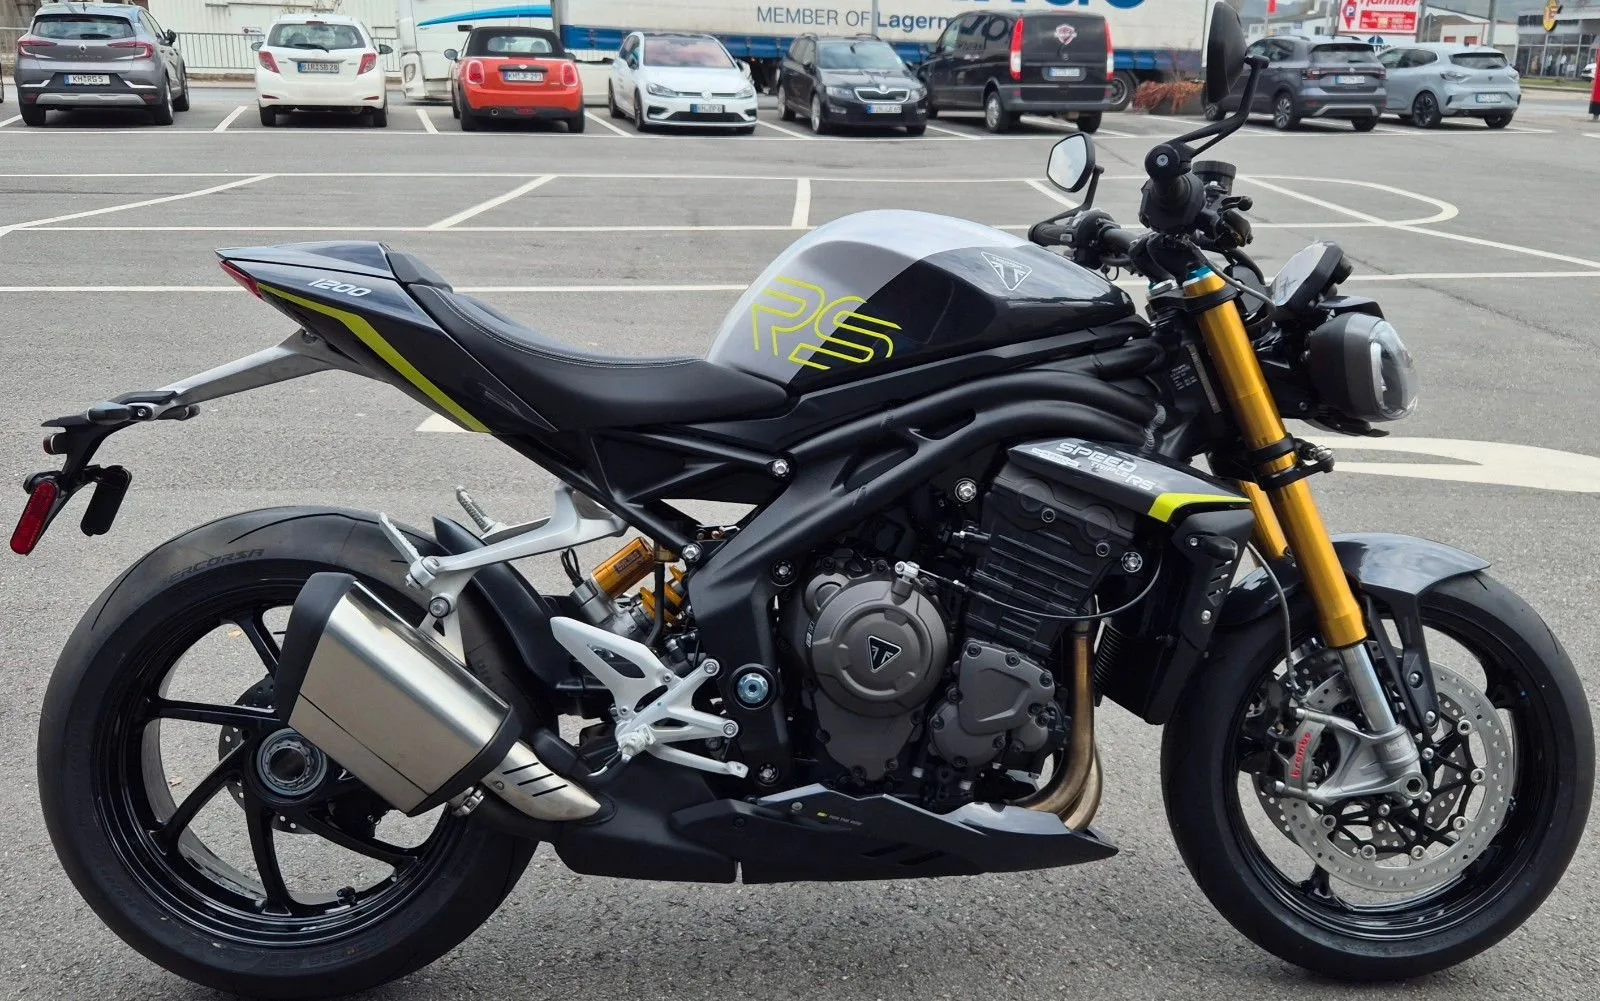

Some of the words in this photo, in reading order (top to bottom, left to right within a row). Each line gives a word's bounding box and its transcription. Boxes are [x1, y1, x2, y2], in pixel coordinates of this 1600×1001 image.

[757, 6, 839, 26] MEMBER
[845, 10, 870, 27] OF
[307, 277, 372, 298] 1200
[751, 275, 903, 371] RS
[1055, 441, 1139, 473] SPEED
[1124, 473, 1157, 492] RS
[1290, 732, 1312, 779] brembo
